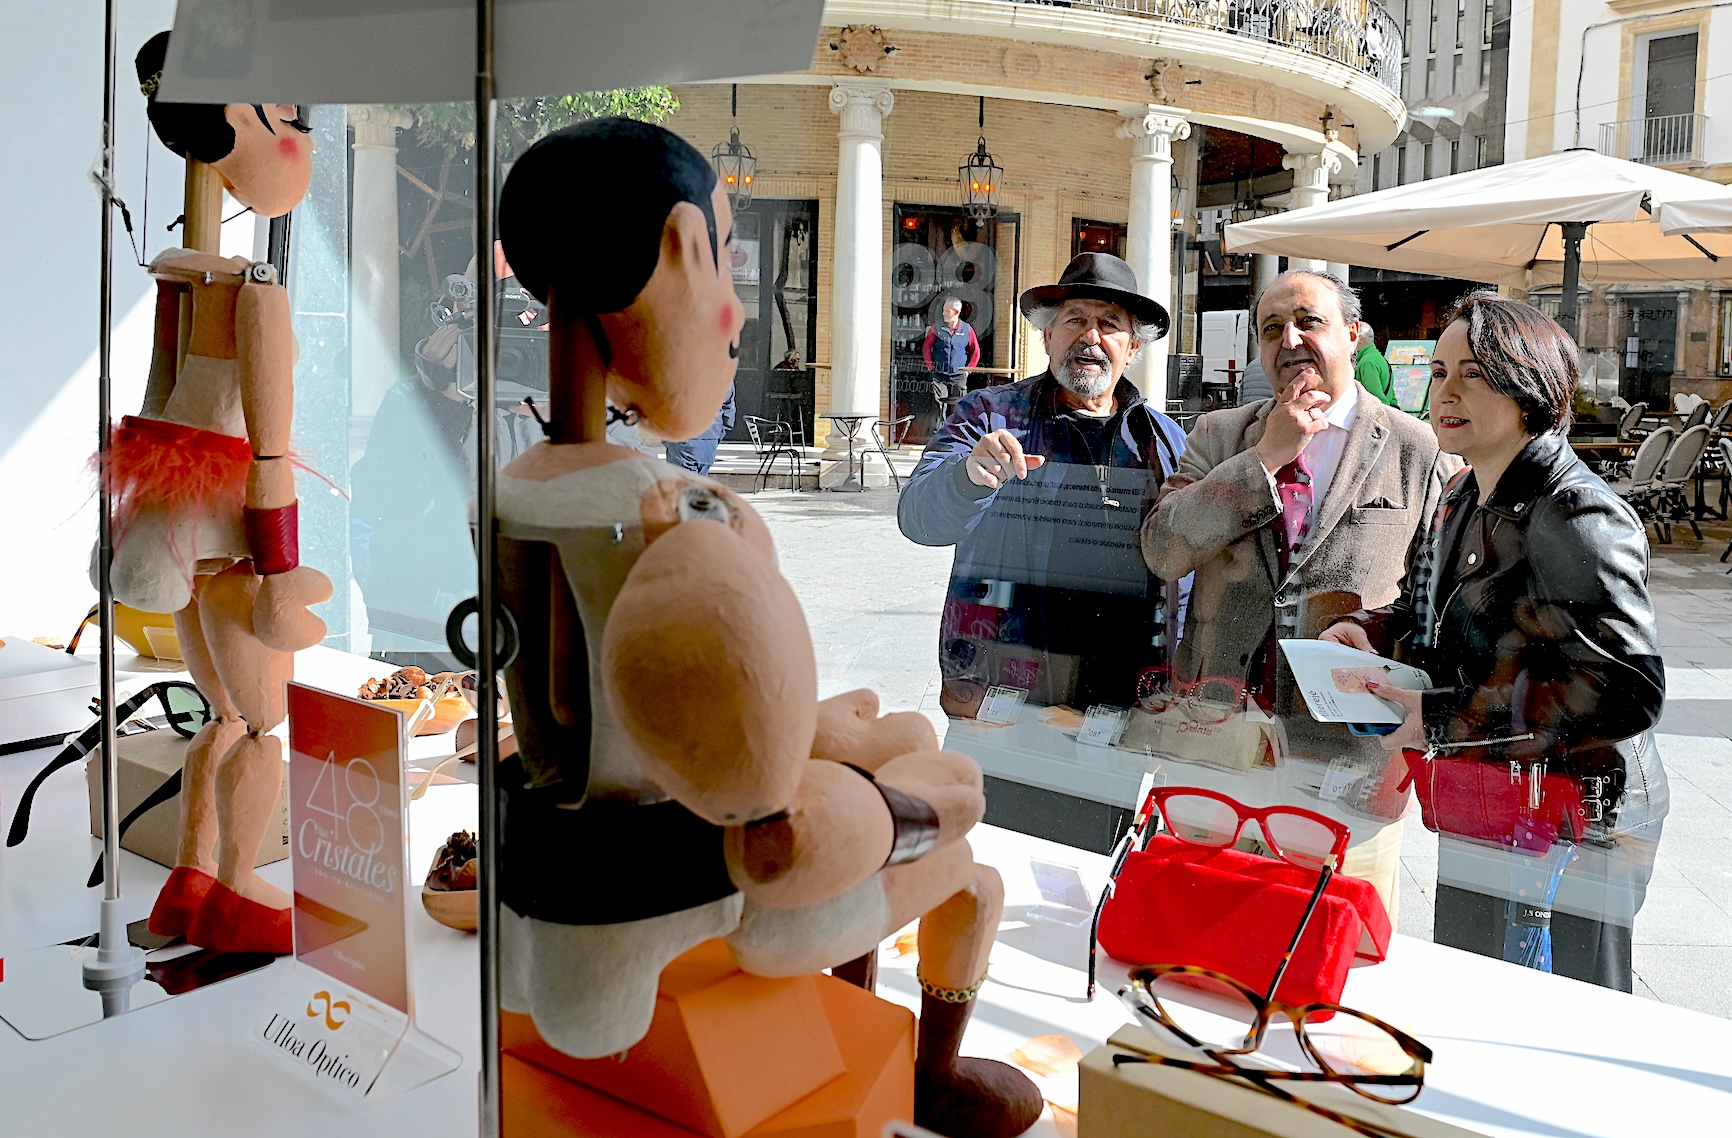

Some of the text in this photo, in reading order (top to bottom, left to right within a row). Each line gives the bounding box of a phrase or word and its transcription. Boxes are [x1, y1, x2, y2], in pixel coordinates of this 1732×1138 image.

[306, 750, 384, 855] 48
[298, 818, 396, 893] Cristales
[263, 1013, 360, 1089] Ulloa Optico
